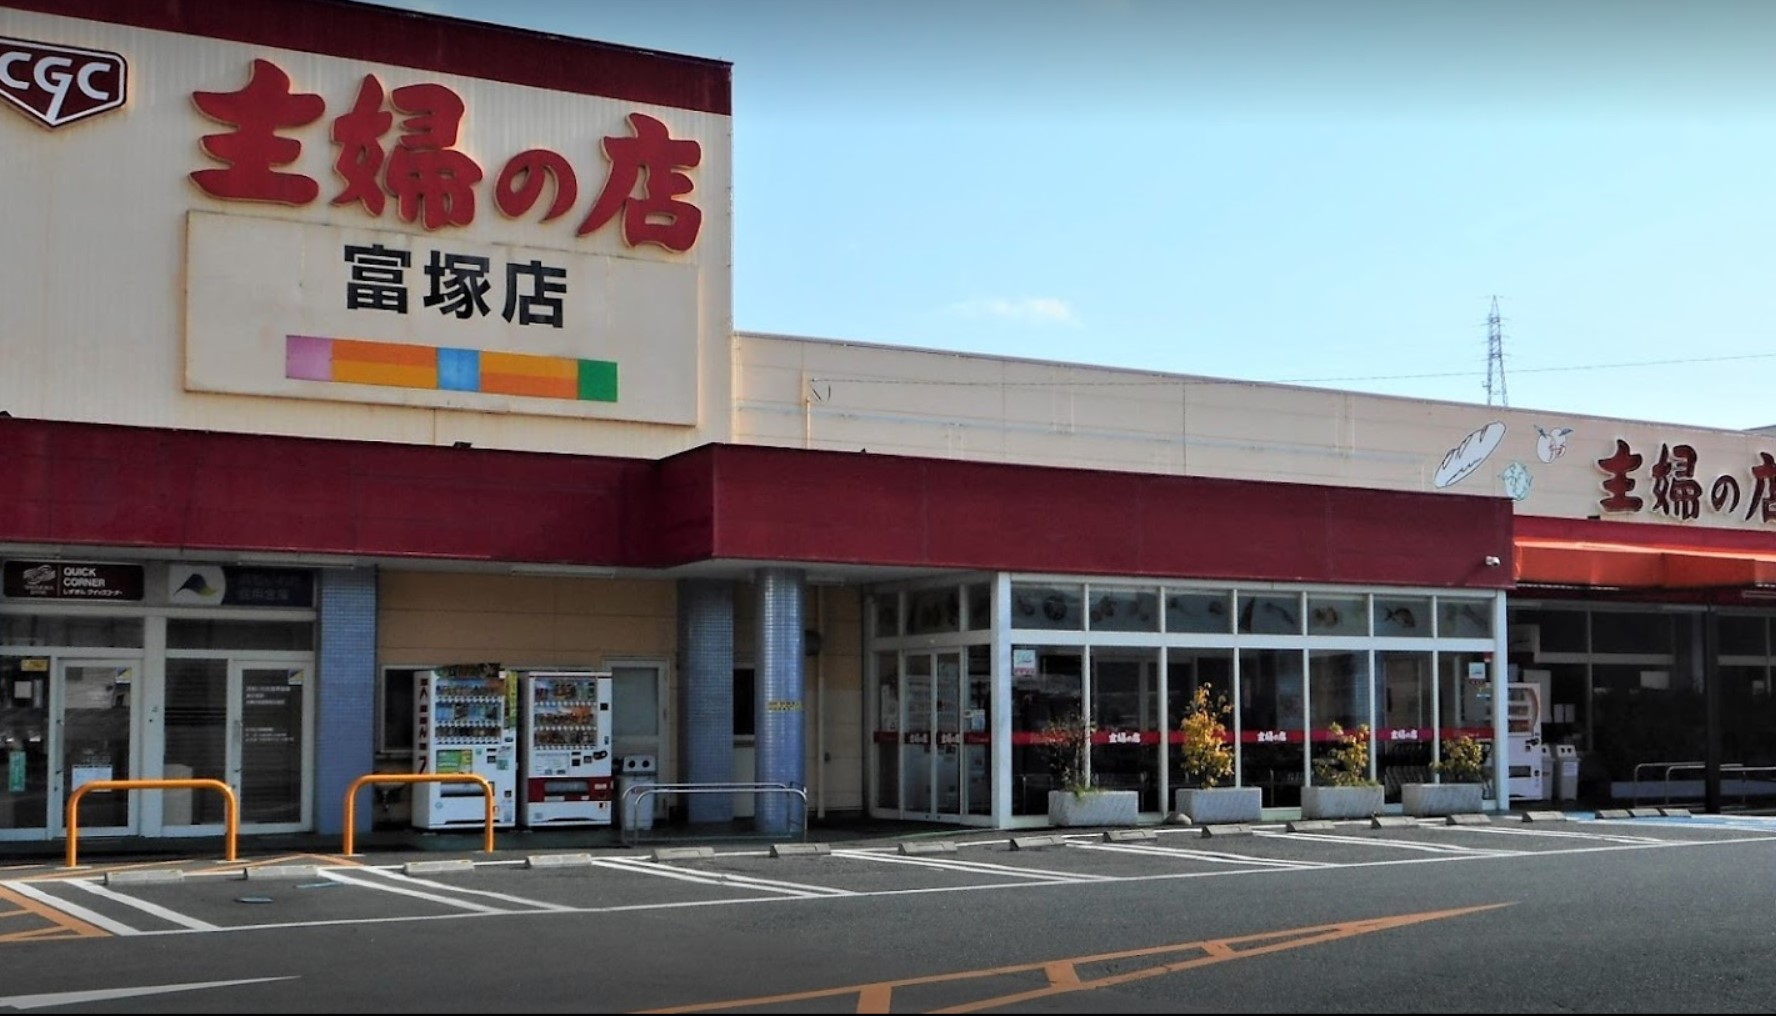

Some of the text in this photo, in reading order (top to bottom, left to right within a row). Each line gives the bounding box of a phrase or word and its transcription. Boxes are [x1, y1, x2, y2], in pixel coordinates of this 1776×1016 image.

[0, 51, 112, 122] CGC
[189, 58, 704, 254] 主婦の店
[344, 243, 568, 329] 富塚店
[1598, 438, 1776, 522] 主婦の店
[63, 567, 97, 577] QUICK
[63, 577, 106, 587] CORNER
